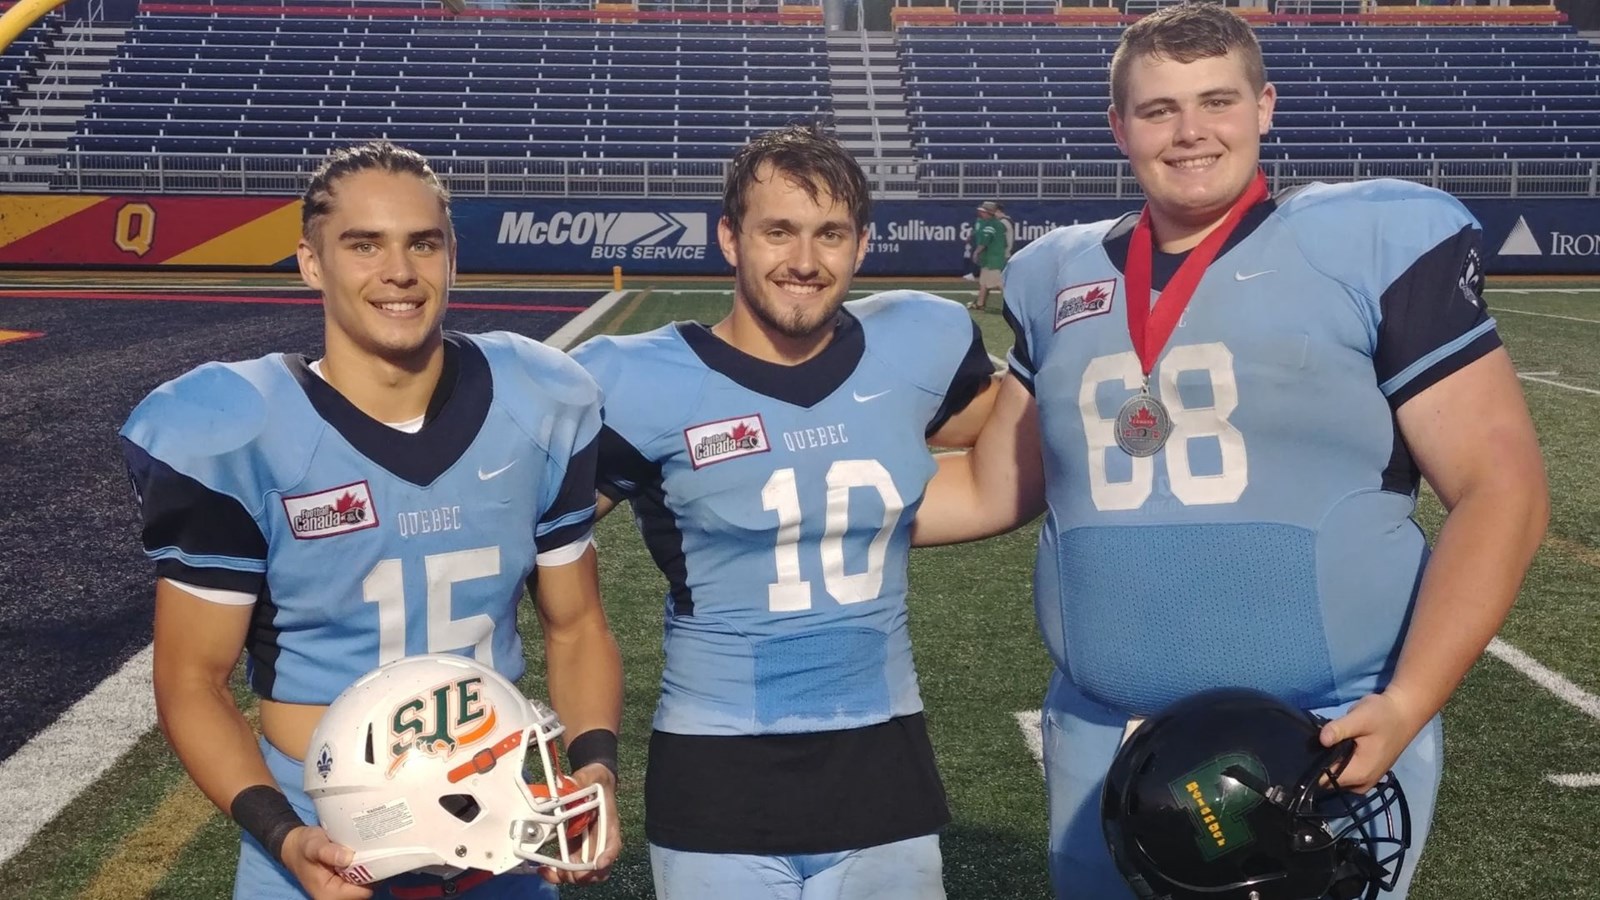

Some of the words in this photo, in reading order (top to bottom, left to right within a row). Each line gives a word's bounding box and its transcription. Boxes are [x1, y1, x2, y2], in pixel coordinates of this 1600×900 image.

[115, 203, 156, 257] Q
[497, 211, 618, 244] McCOY
[887, 219, 955, 241] Sullivan
[959, 221, 973, 240] &
[591, 246, 626, 259] BUS
[631, 246, 706, 259] SERVICE
[878, 243, 899, 253] 1914
[783, 423, 849, 452] QUEBEC
[1079, 341, 1248, 511] 68
[695, 437, 737, 460] Canada
[294, 510, 341, 532] Canada
[398, 506, 462, 538] QUEBEC
[761, 459, 904, 612] 10
[362, 545, 501, 669] 15
